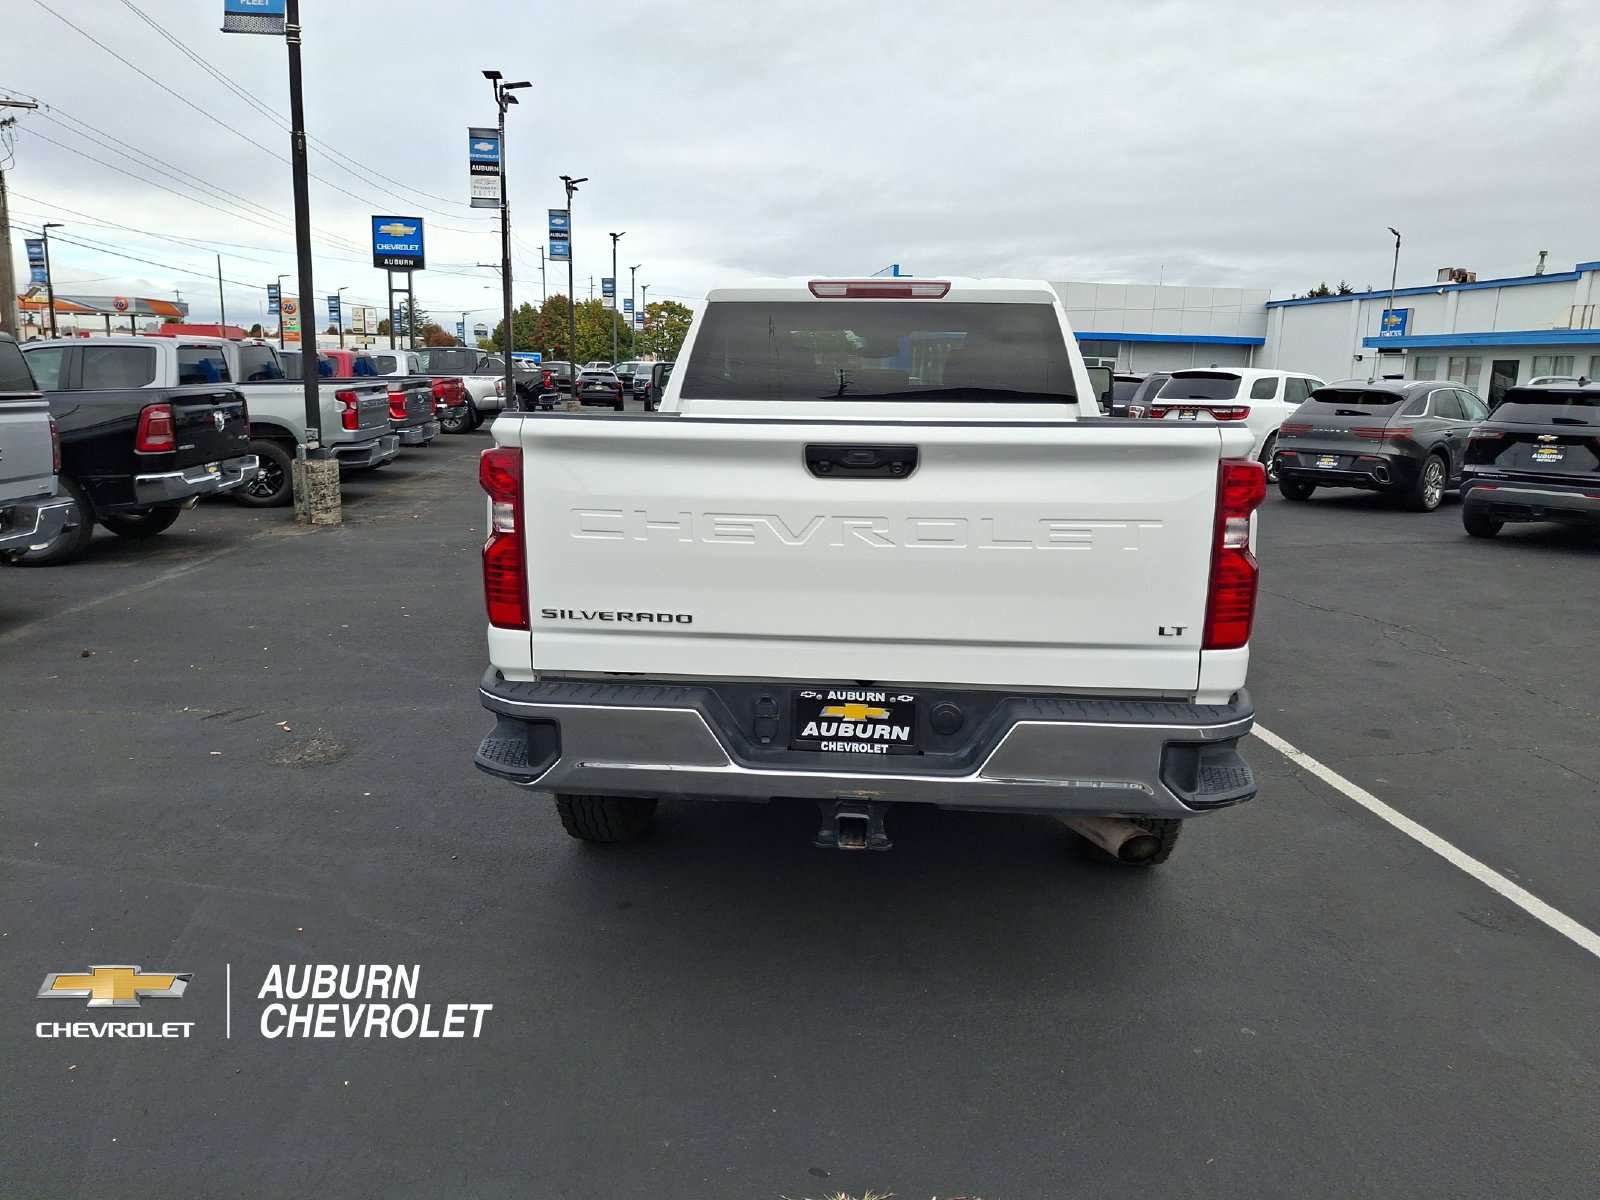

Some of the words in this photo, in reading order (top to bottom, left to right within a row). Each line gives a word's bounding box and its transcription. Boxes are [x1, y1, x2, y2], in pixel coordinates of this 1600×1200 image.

[471, 164, 499, 172] AUBURN
[376, 243, 420, 251] CHEVROLET
[384, 258, 414, 266] AUBURN
[570, 508, 1164, 551] CHEVROLET
[541, 608, 693, 624] SILVERADO
[1158, 625, 1188, 637] LT
[827, 690, 886, 702] AUBURN
[801, 721, 910, 741] AUBURN
[820, 741, 889, 754] CHEVROLET
